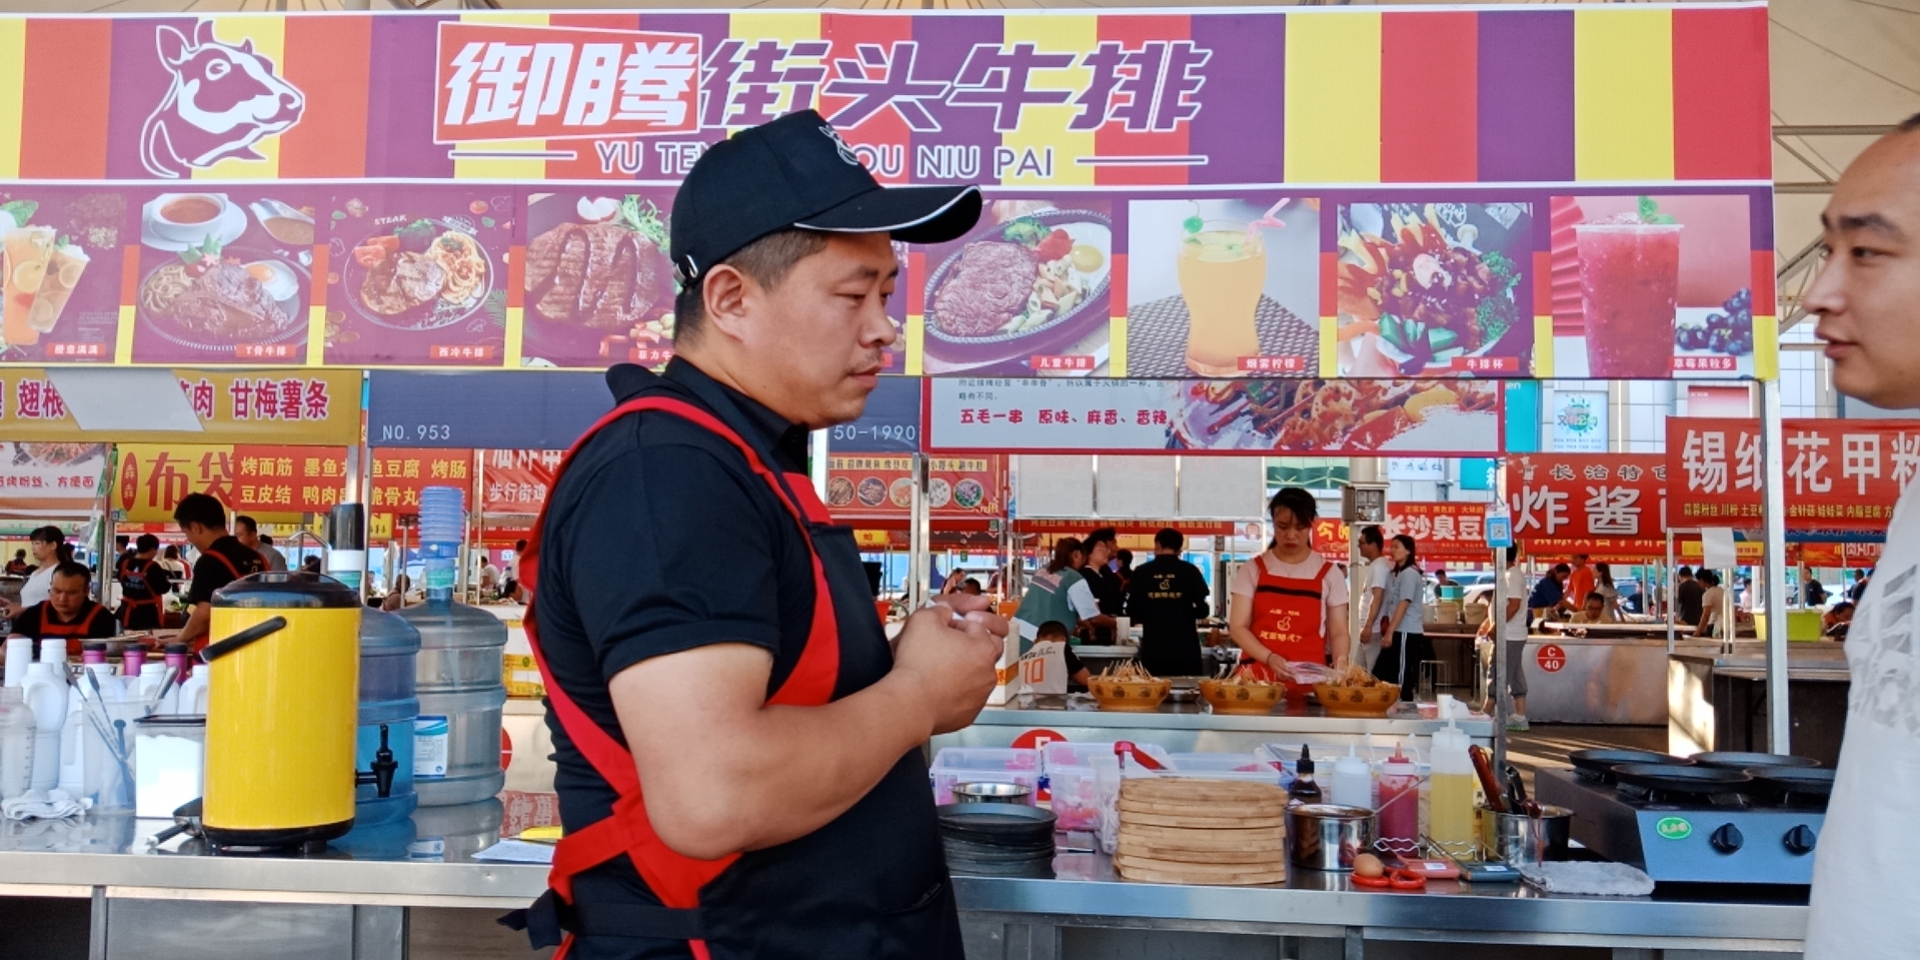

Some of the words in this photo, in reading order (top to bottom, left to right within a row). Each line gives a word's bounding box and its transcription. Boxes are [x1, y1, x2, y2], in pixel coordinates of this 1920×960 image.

[595, 141, 643, 174] YU
[655, 141, 709, 174] TE
[850, 144, 904, 178] OU
[917, 145, 980, 178] NIU
[994, 146, 1054, 178] PAI
[438, 346, 485, 358] 西冷牛排
[1673, 357, 1733, 369] 草莓果粒多
[18, 379, 64, 418] 翅根
[230, 379, 329, 419] 甘梅薯条
[960, 408, 1023, 424] 五毛一串
[833, 424, 916, 441] 50-1990
[240, 457, 293, 477] 烤面筋
[431, 459, 467, 479] 烤肠
[240, 485, 292, 504] 豆皮结
[1512, 485, 1667, 535] 炸酱
[1382, 514, 1488, 540] 长沙臭豆
[1546, 645, 1556, 657] C
[1023, 657, 1045, 685] 10
[1543, 658, 1560, 670] 40
